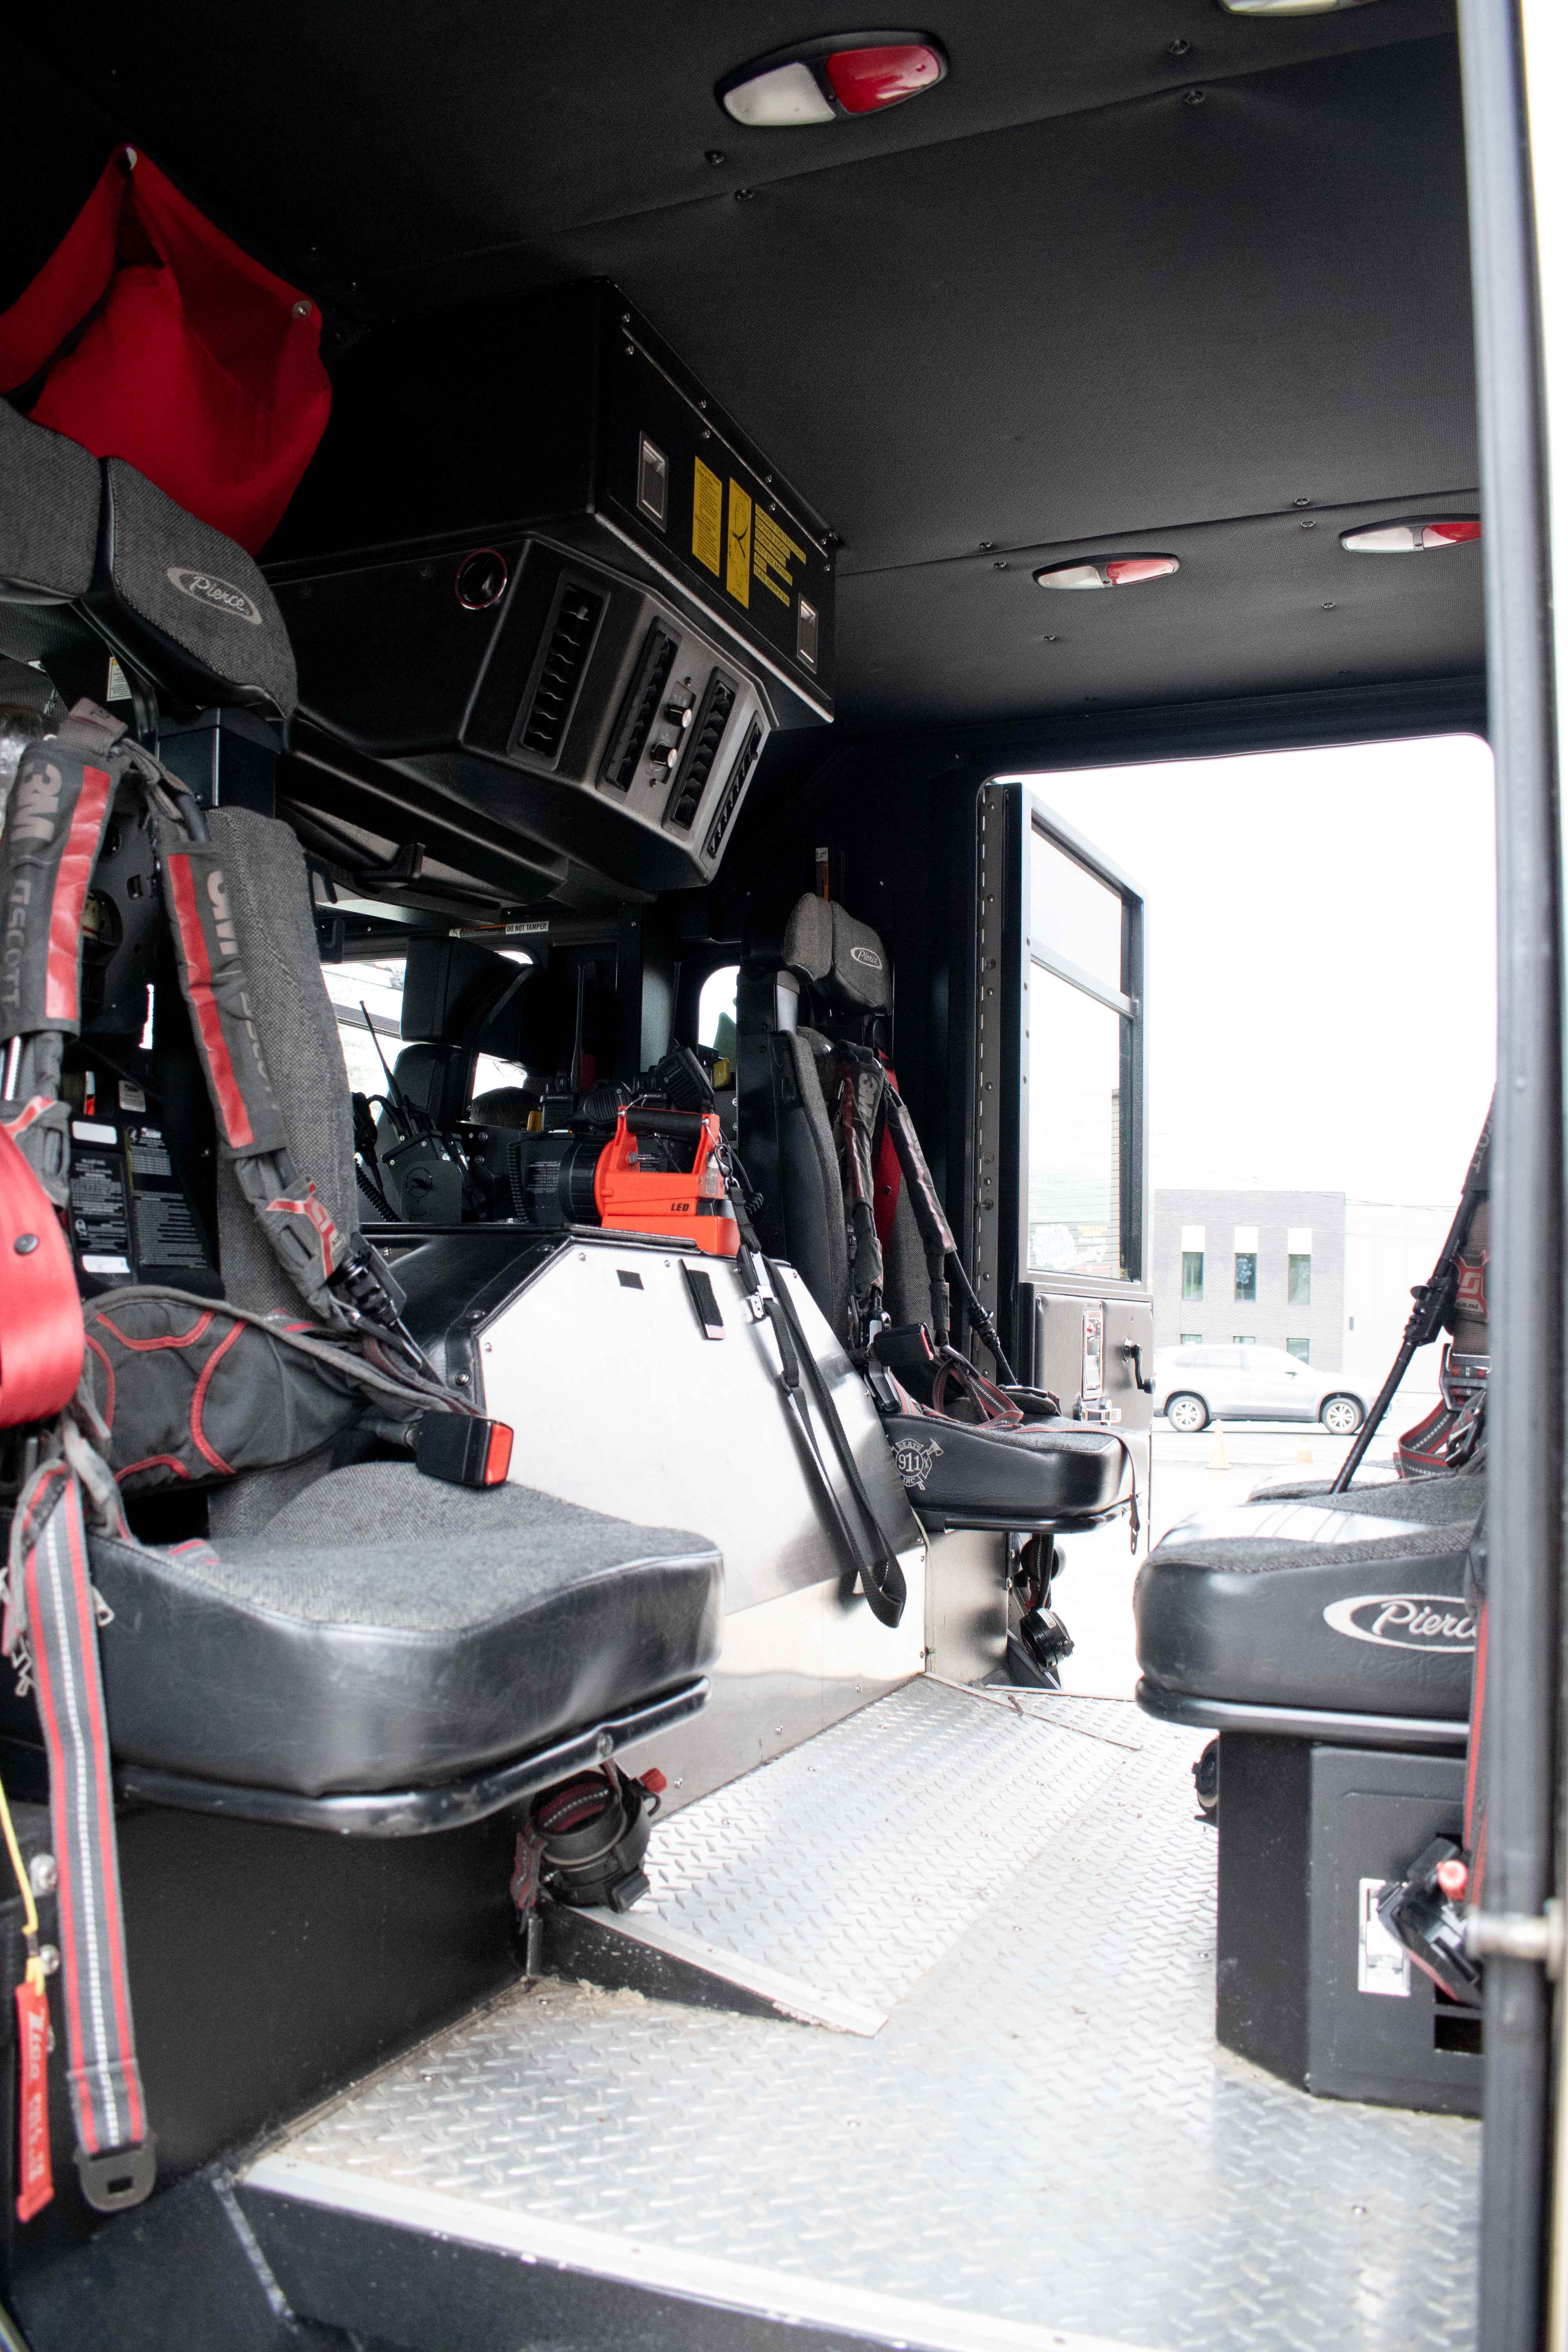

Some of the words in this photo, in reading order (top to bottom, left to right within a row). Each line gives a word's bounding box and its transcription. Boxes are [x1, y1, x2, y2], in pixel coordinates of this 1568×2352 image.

[757, 507, 775, 526] SMOKE
[756, 518, 773, 540] SPARE
[755, 555, 766, 569] AED
[755, 567, 766, 581] GAS
[190, 577, 245, 611] Pierce
[11, 762, 62, 842] 3M
[858, 949, 878, 965] Pierce
[858, 1073, 877, 1118] 3M
[671, 1203, 690, 1212] LED
[899, 1442, 921, 1450] SEATS
[898, 1452, 920, 1472] 911
[1372, 1600, 1477, 1638] Pierc
